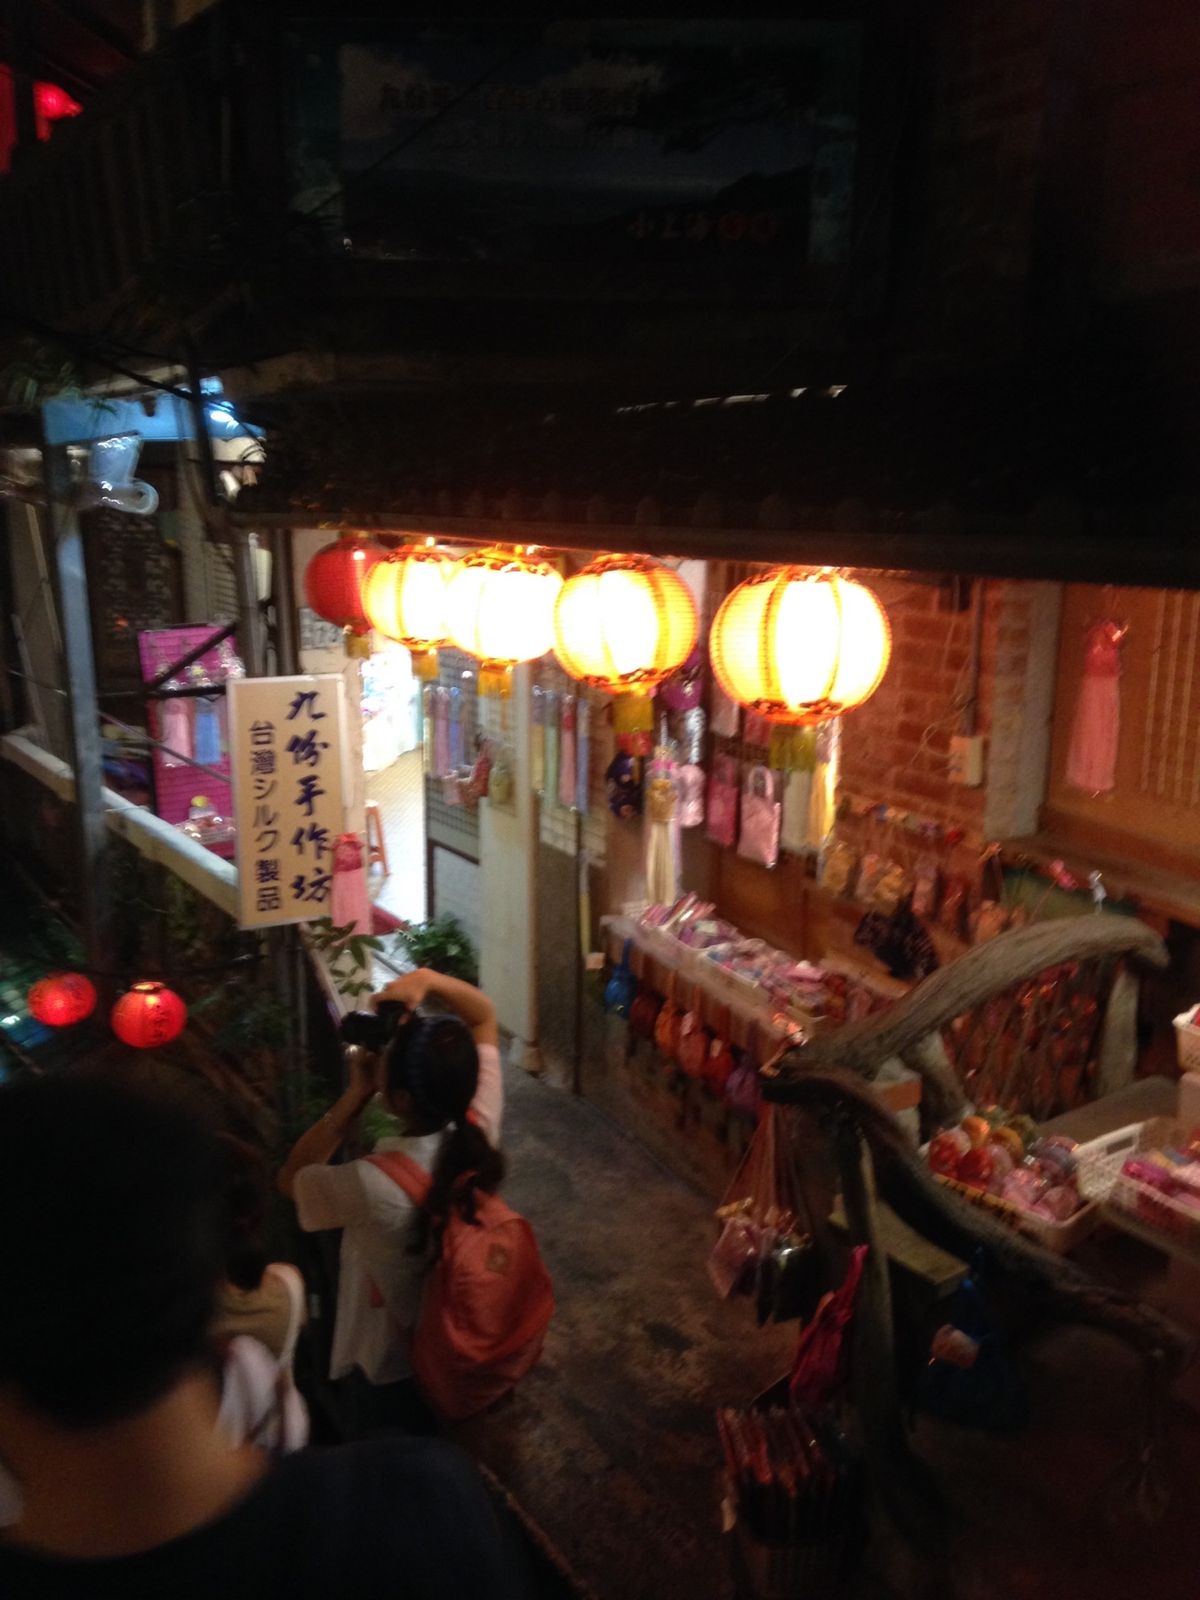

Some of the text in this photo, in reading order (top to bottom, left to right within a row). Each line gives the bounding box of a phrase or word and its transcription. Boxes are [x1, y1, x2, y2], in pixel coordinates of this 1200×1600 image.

[249, 720, 281, 912] 台灣シルク製品
[286, 690, 333, 903] 九份手作坊
